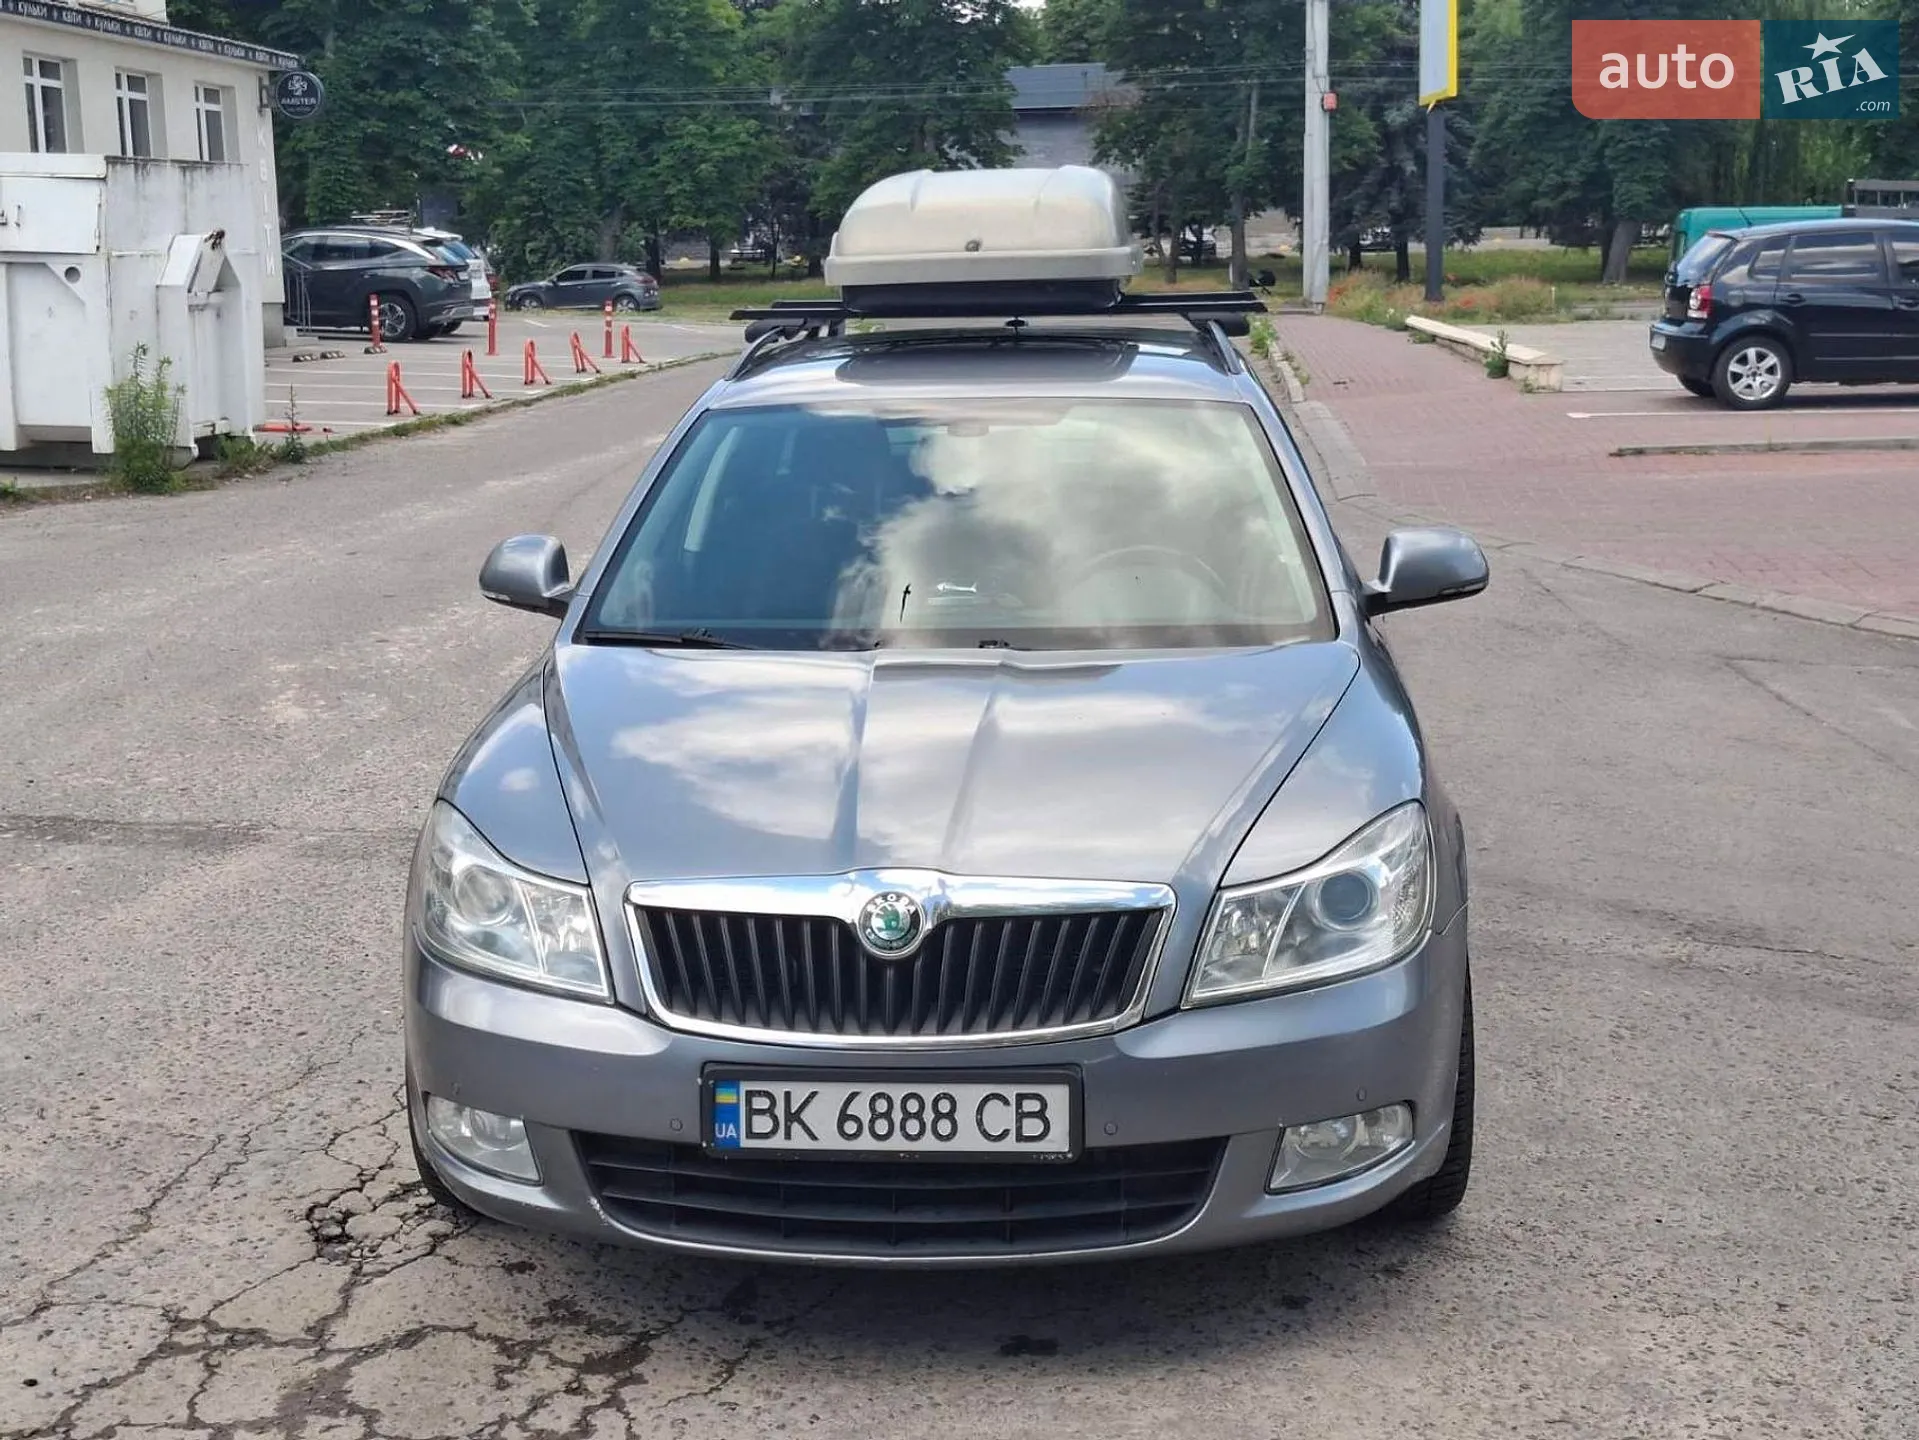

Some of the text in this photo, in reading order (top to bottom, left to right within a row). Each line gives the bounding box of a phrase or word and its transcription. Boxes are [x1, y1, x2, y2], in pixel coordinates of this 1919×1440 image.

[715, 1122, 738, 1139] UA
[744, 1089, 1051, 1143] BK 6888 CB
